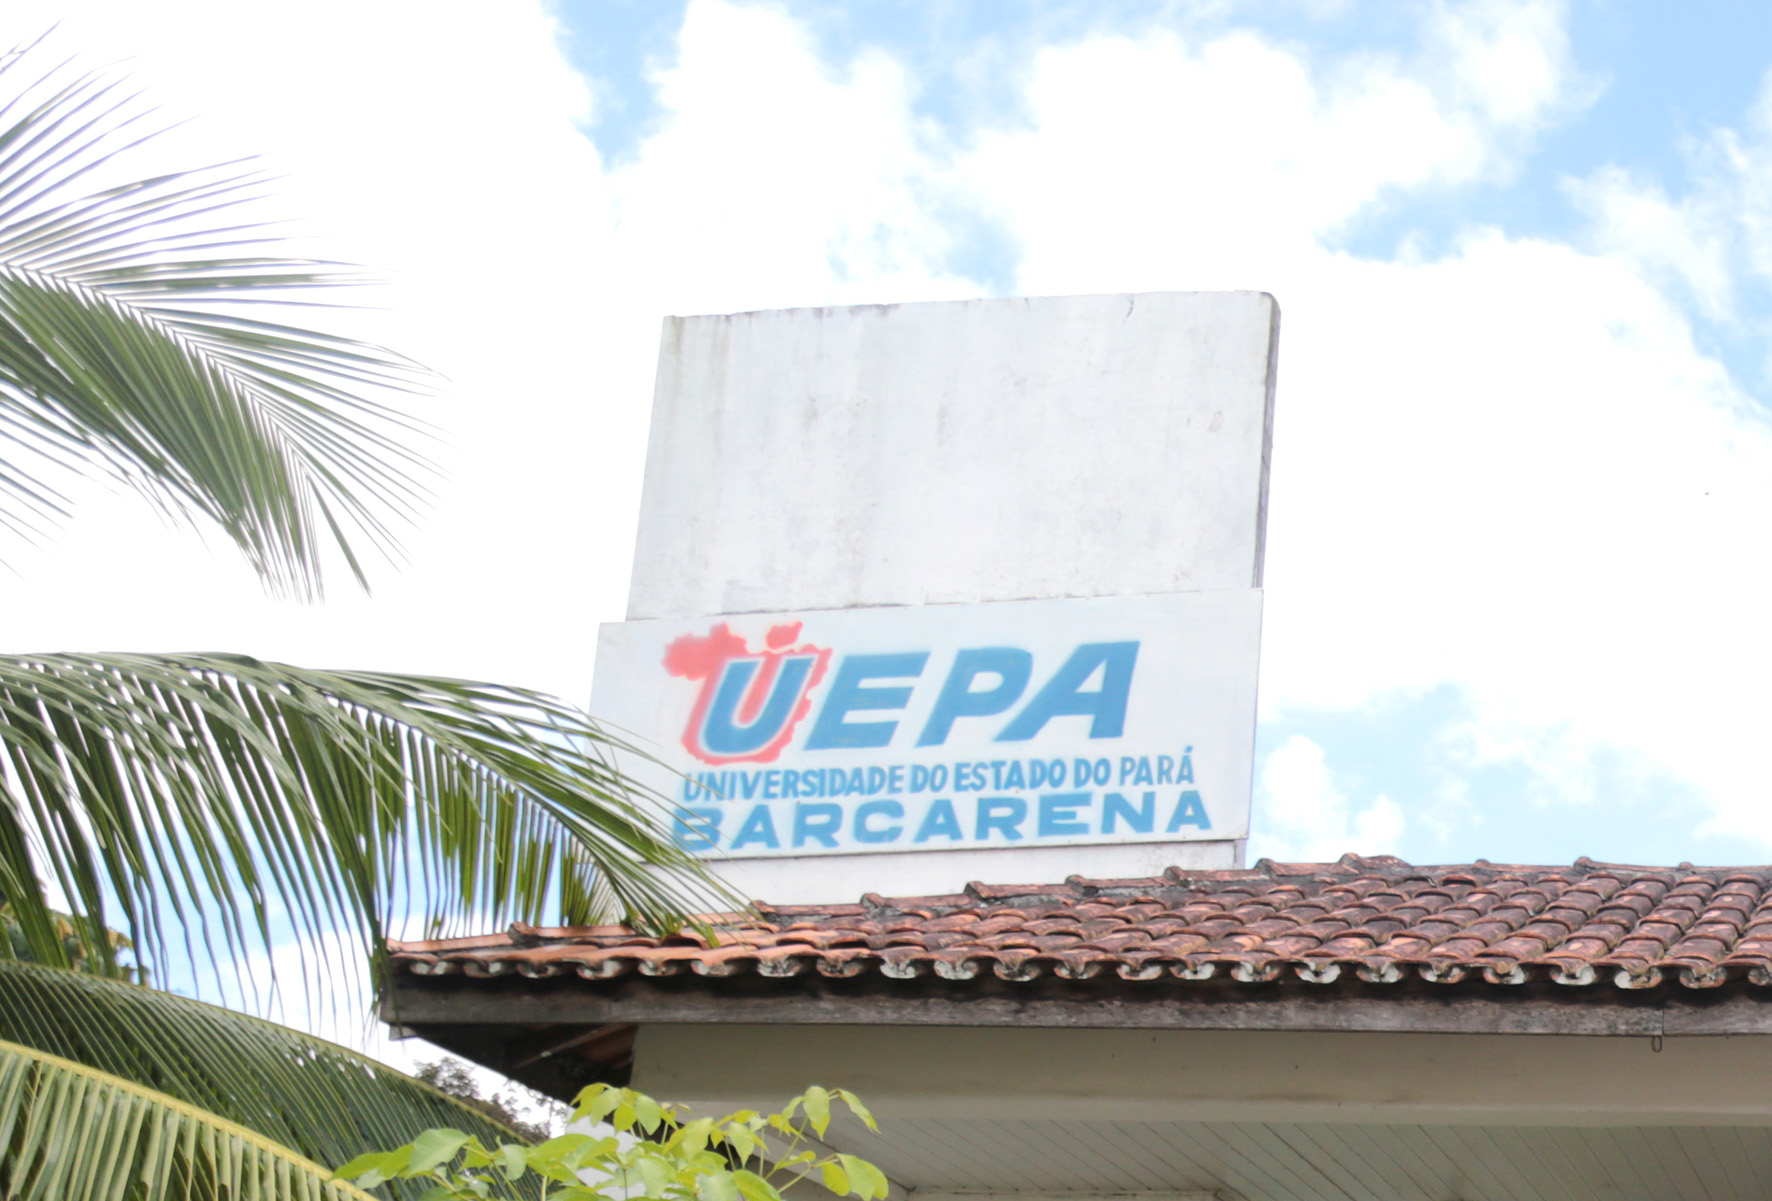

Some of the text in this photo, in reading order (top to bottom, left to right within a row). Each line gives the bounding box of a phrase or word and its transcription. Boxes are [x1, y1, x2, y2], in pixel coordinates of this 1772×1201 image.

[702, 641, 1140, 755] UEPA
[683, 745, 1195, 801] UNIVERSIDADE DO ESTADO DO PARÁ
[670, 790, 1212, 852] BARCARENA
